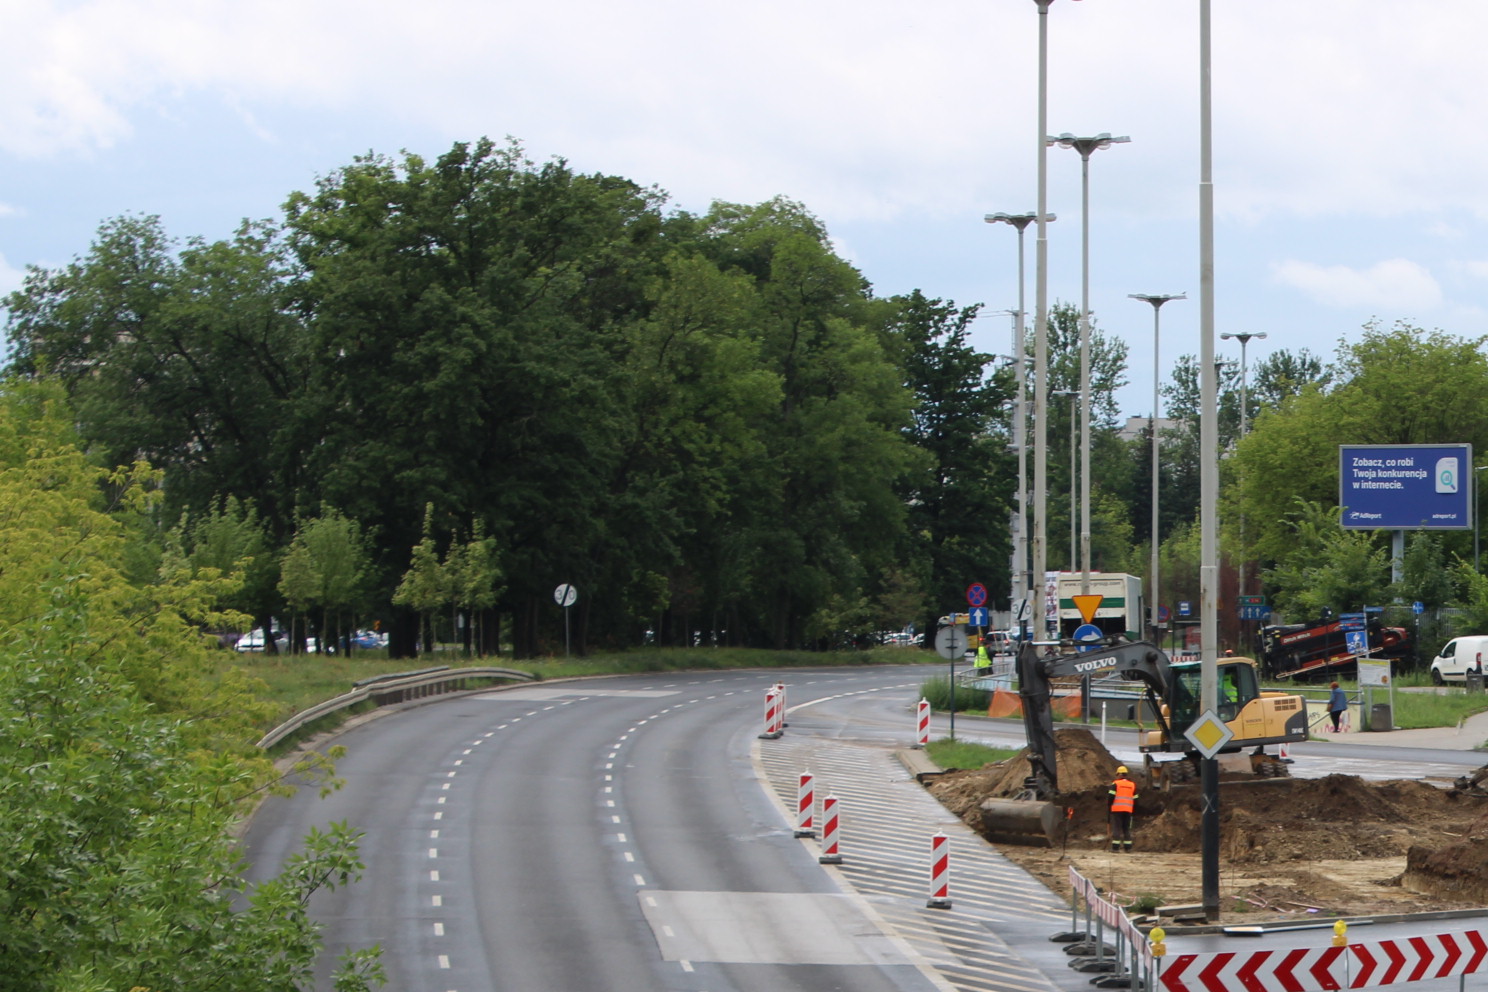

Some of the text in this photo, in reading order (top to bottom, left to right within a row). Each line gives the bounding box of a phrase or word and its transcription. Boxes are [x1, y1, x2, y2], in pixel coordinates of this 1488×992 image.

[1352, 457, 1385, 468] Zobacz,
[1397, 457, 1414, 467] robi
[1352, 469, 1427, 479] Twoja konkurencja
[1074, 656, 1117, 672] VOLVO
